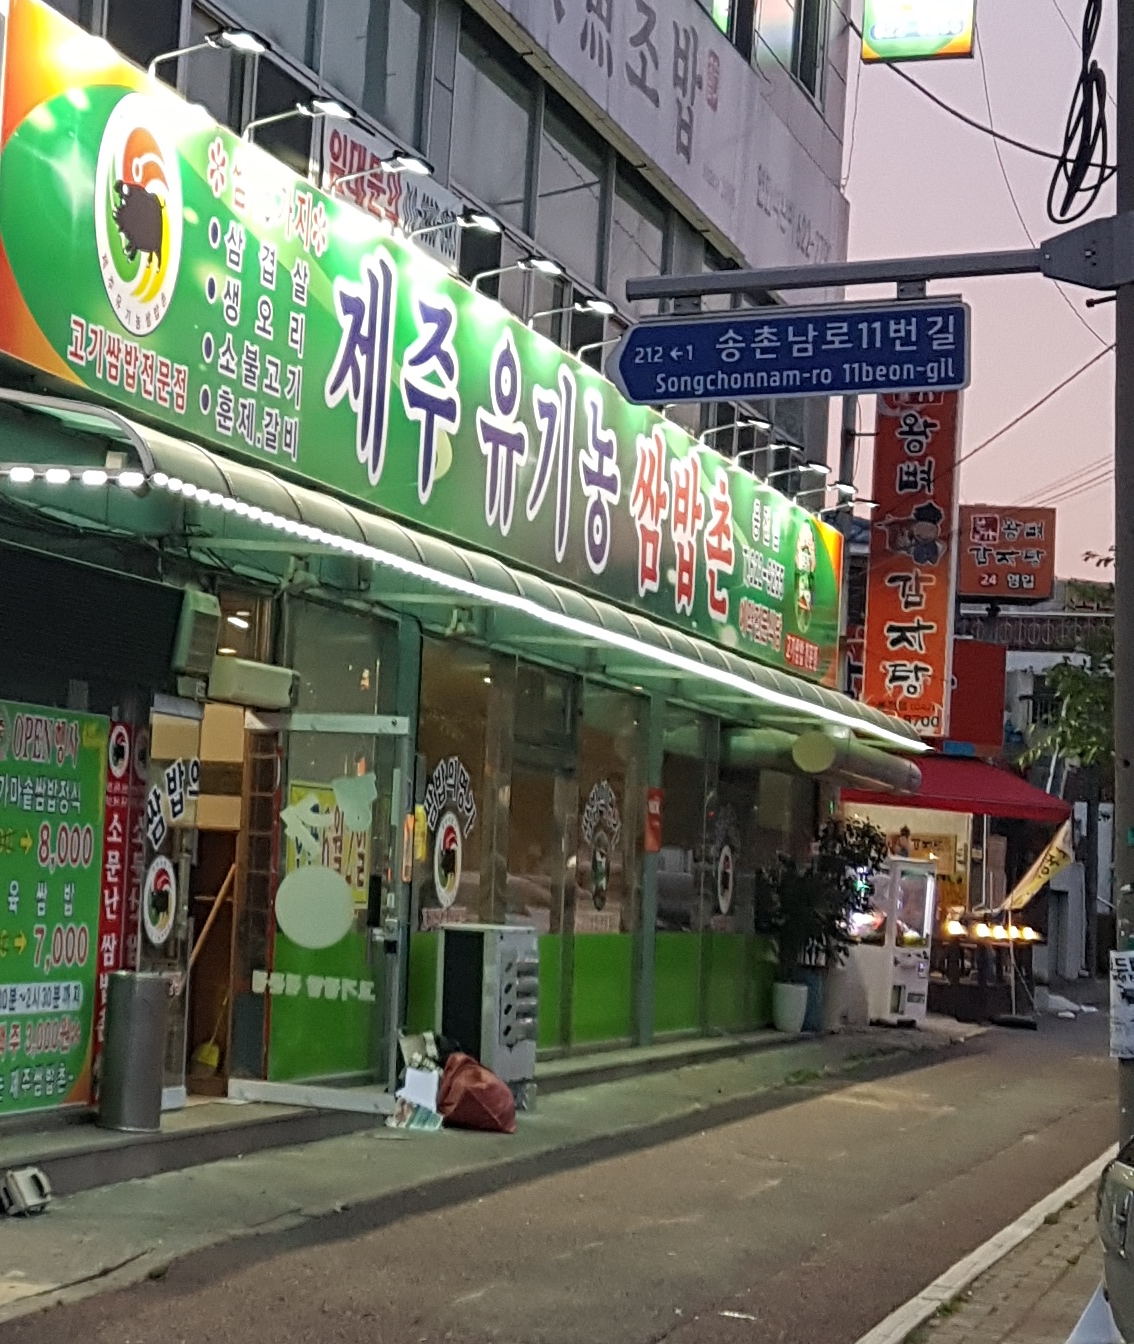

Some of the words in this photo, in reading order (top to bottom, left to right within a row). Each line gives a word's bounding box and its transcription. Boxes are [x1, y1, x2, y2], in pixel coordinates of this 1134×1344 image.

[223, 278, 305, 358] 생오리
[716, 315, 955, 362] 송촌남로11번길
[68, 314, 188, 414] 고기쌈밥전문점
[218, 333, 302, 410] 소불고기
[656, 365, 832, 394] Songchonnam-ro
[842, 357, 955, 384] 11beon-gil
[326, 245, 460, 504] 제주
[476, 327, 620, 575] 유기농
[630, 424, 735, 622] 쌈밥촌
[885, 568, 938, 698] 감자탕
[38, 821, 94, 875] 8,000
[103, 814, 122, 921] 소문난
[33, 922, 89, 975] 7,000
